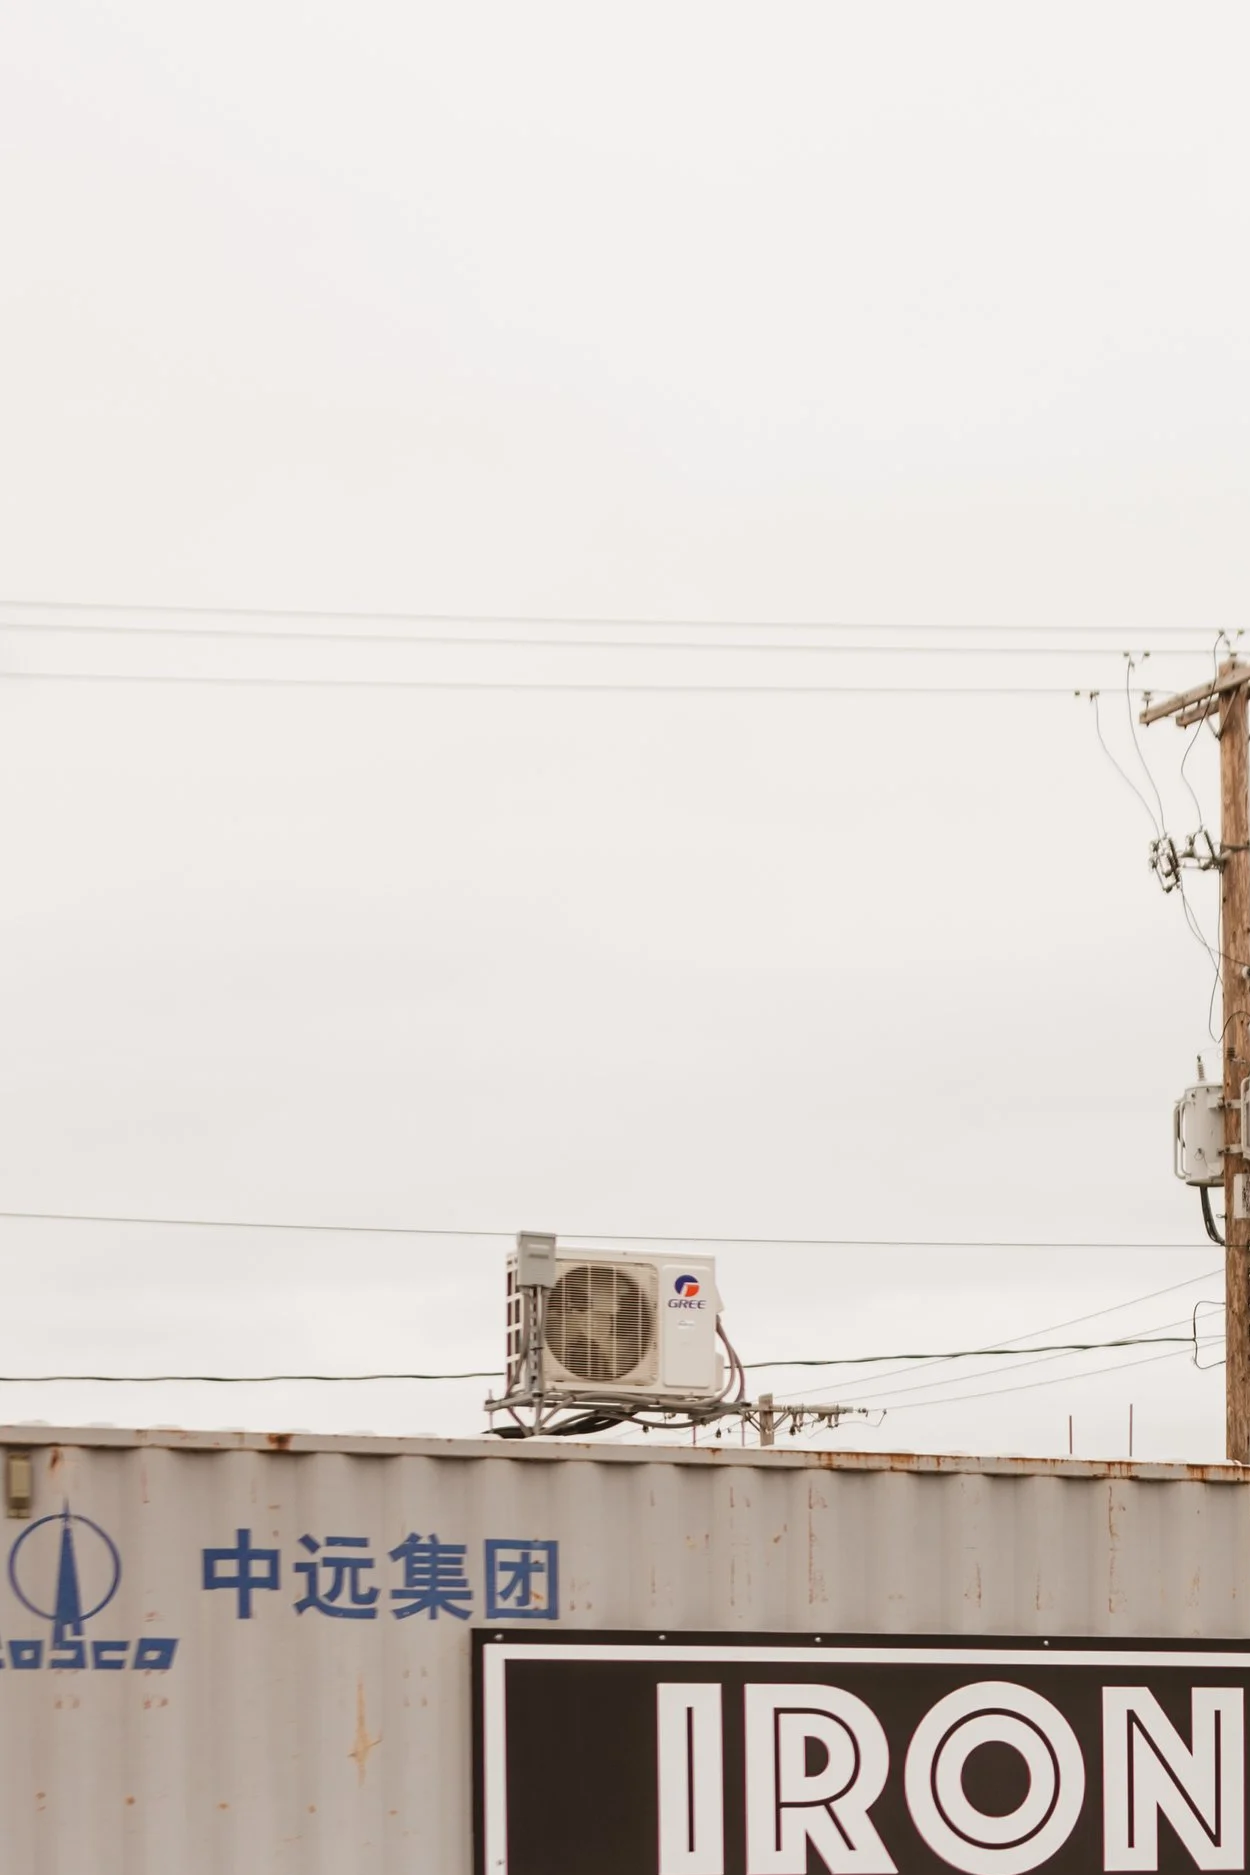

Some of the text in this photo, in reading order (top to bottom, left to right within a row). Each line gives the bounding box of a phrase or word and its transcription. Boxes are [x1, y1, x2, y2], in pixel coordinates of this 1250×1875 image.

[667, 1298, 707, 1310] GREE
[201, 1528, 560, 1620] 中远集团
[0, 1628, 179, 1670] OSCO
